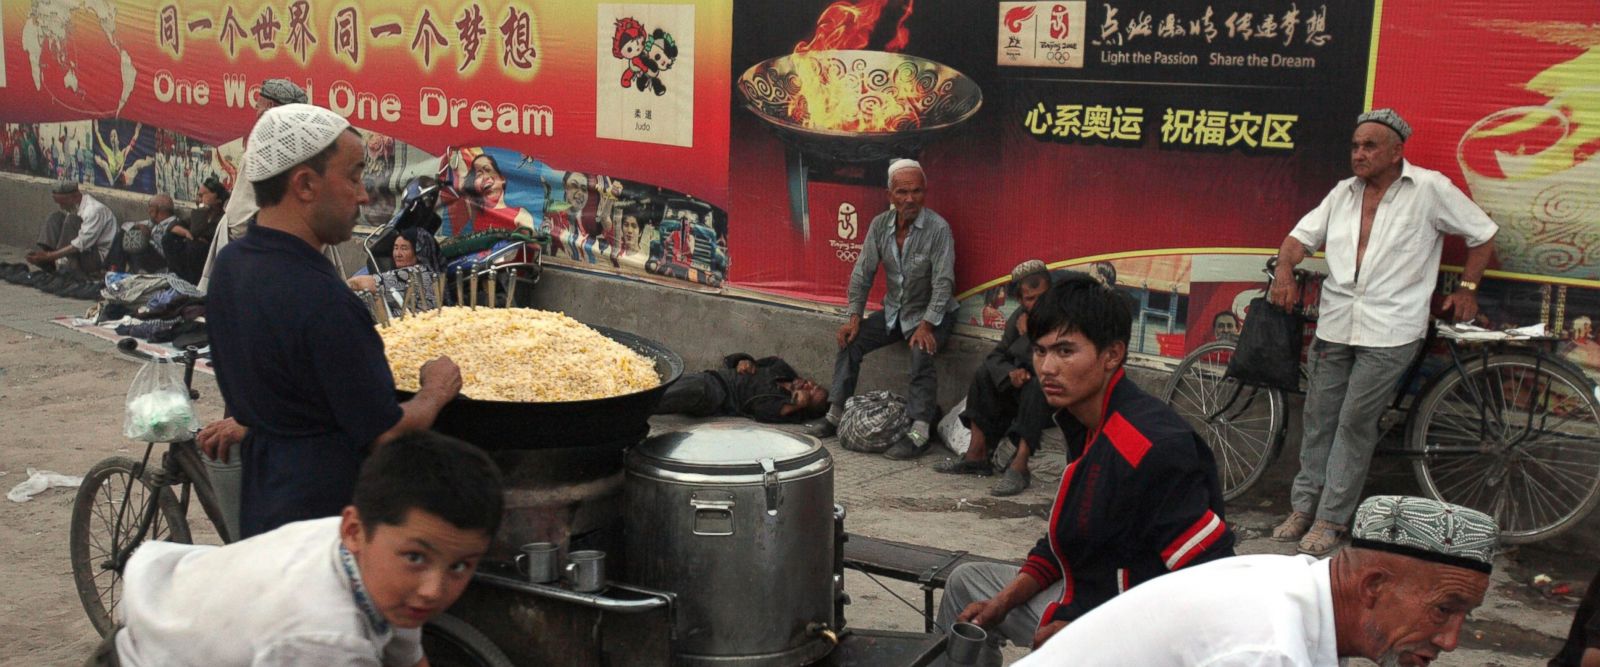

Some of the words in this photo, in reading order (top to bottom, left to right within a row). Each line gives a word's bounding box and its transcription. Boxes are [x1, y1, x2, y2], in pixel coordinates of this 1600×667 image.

[1101, 51, 1130, 65] Light
[1132, 52, 1151, 64] the
[1154, 52, 1198, 65] Passion
[1209, 52, 1245, 66] Share
[1247, 53, 1268, 66] the
[1271, 54, 1316, 68] Dream
[153, 69, 210, 105] One
[329, 79, 402, 122] One
[419, 86, 554, 137] Dream
[634, 122, 651, 131] Judo
[1024, 102, 1144, 140] 心系奥运
[1160, 107, 1299, 148] 祝福灾区
